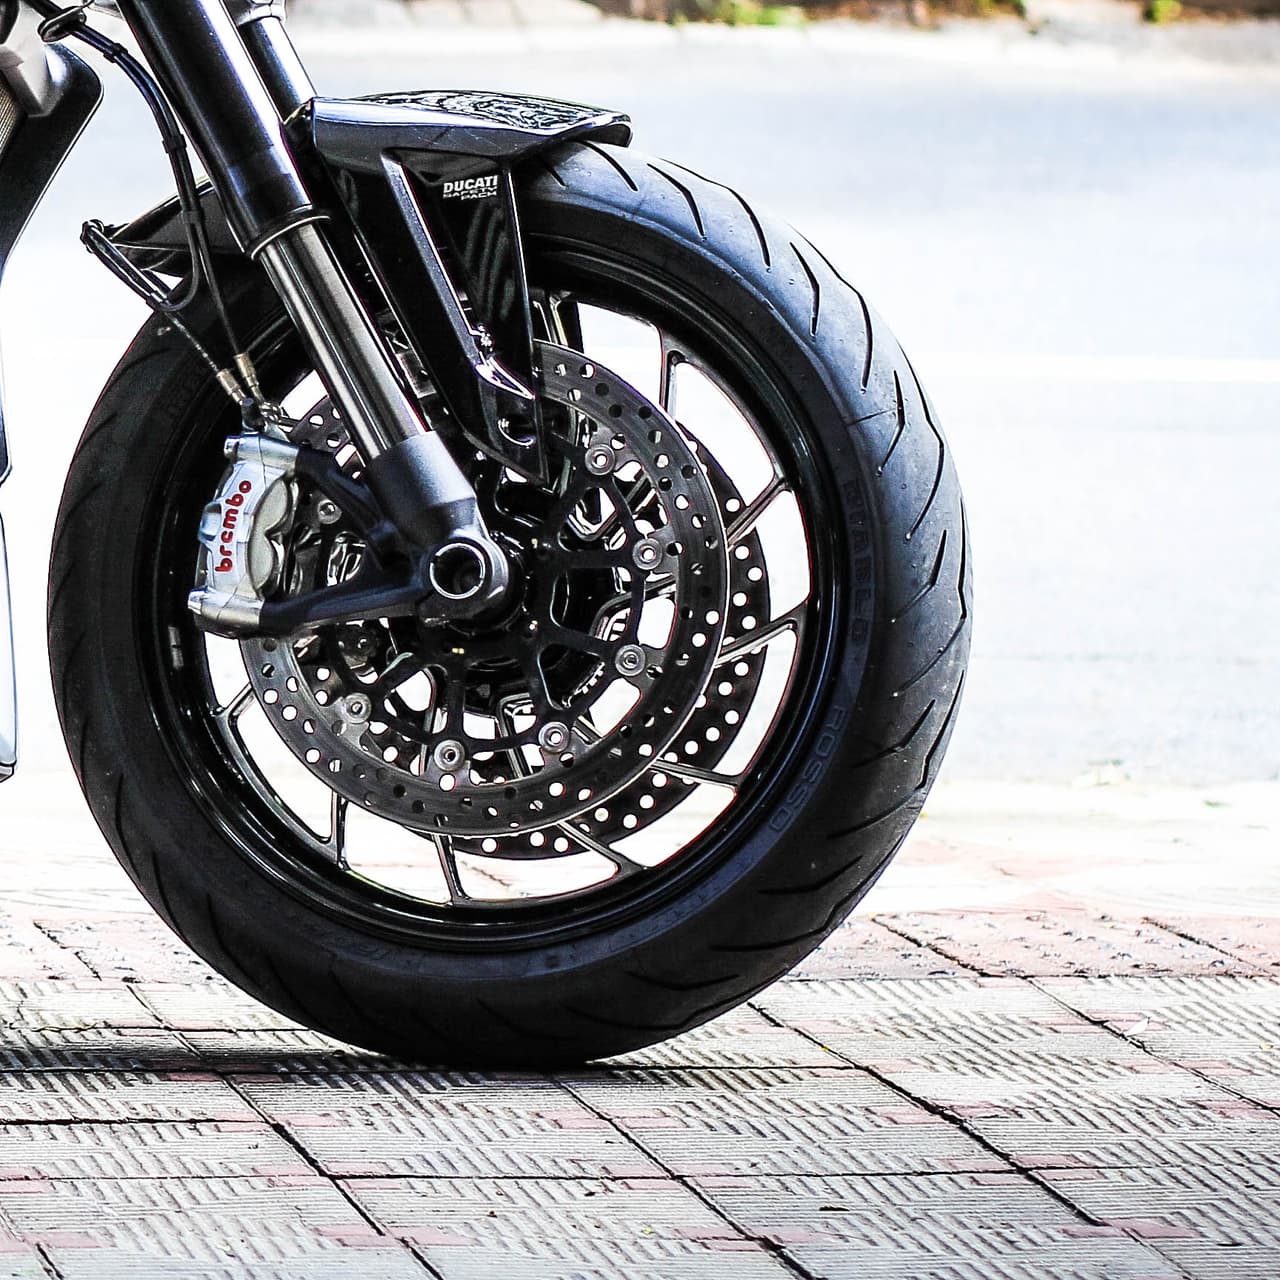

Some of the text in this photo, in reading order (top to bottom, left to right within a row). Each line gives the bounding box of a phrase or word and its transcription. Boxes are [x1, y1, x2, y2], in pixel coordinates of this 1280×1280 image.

[443, 175, 499, 194] DUCATI
[215, 480, 252, 573] brembo
[768, 704, 849, 832] ROSSO
